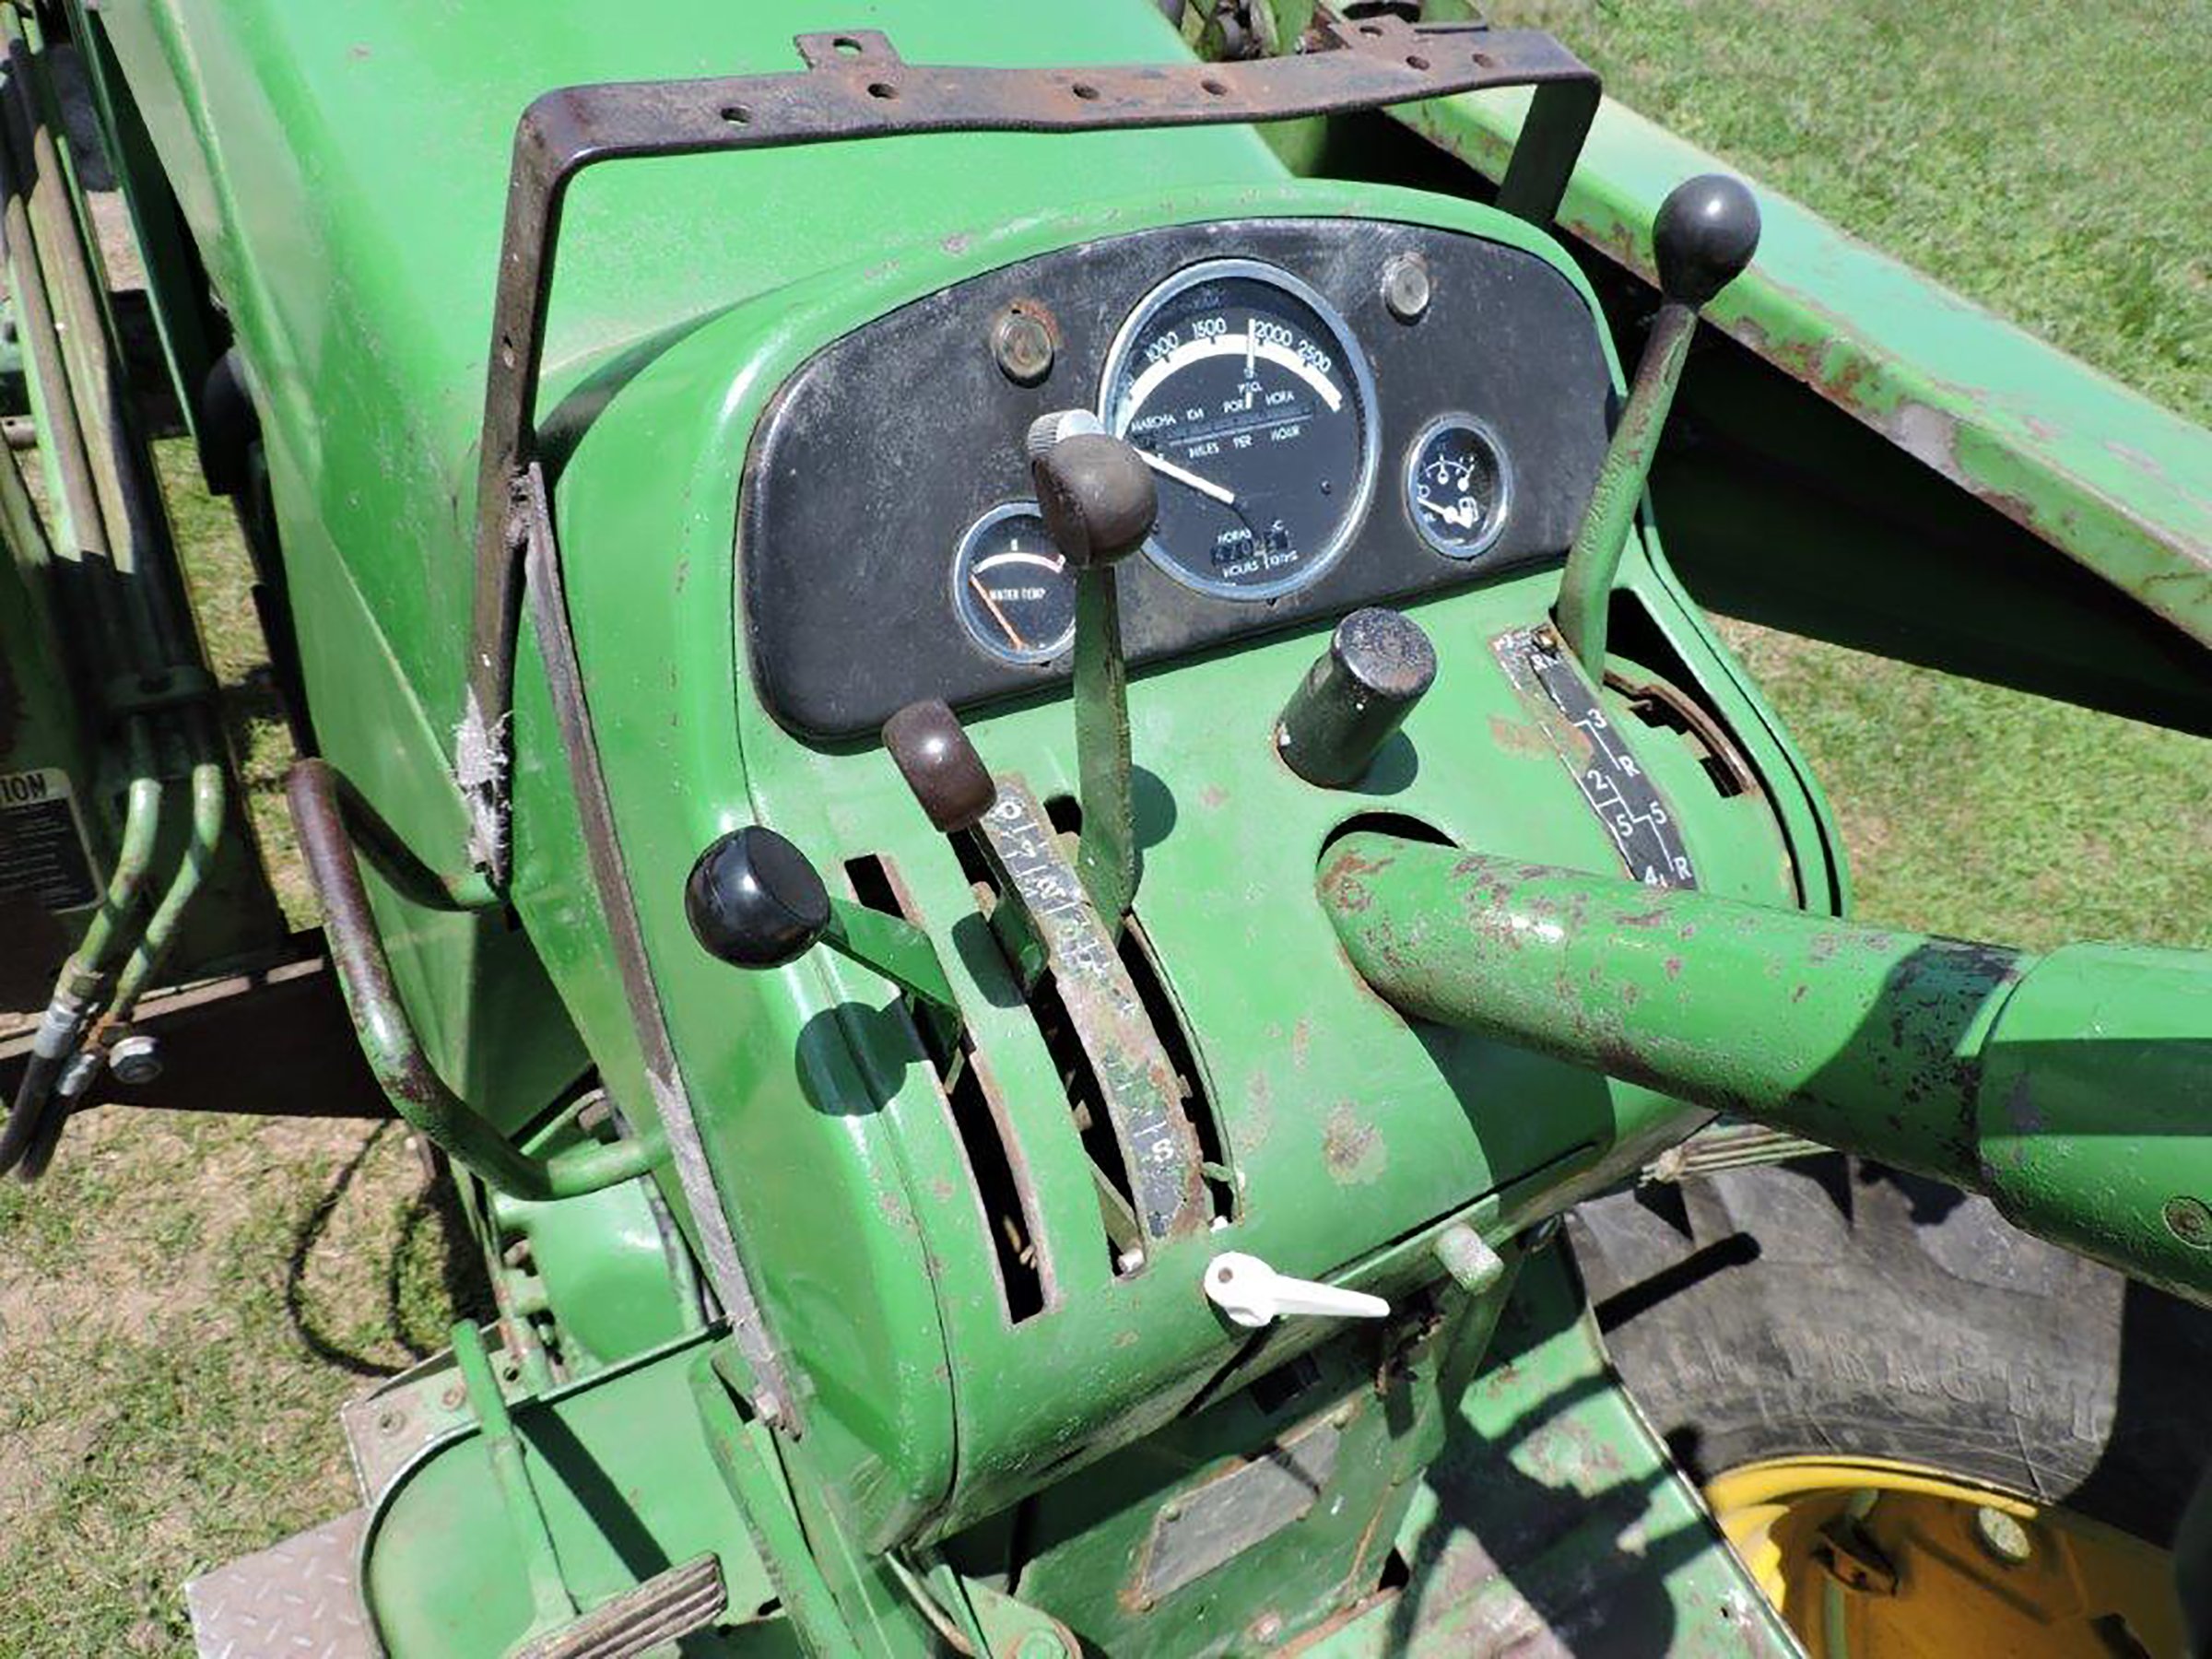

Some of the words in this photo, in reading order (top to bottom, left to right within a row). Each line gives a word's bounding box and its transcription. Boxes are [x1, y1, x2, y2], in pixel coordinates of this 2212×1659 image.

[1192, 317, 1227, 339] 1500
[1255, 321, 1292, 347] 2000
[1145, 332, 1180, 362] 1000
[1298, 339, 1332, 373] 2500
[1189, 442, 1219, 459] MILES
[1233, 434, 1253, 450] PER
[1271, 425, 1300, 441] HOUR
[1587, 708, 1607, 729] 3
[1618, 755, 1641, 778] R
[1587, 769, 1608, 791] 2
[1650, 800, 1667, 824] 5
[1616, 813, 1634, 837] 5
[1643, 865, 1658, 886] 4
[1674, 856, 1692, 880] R
